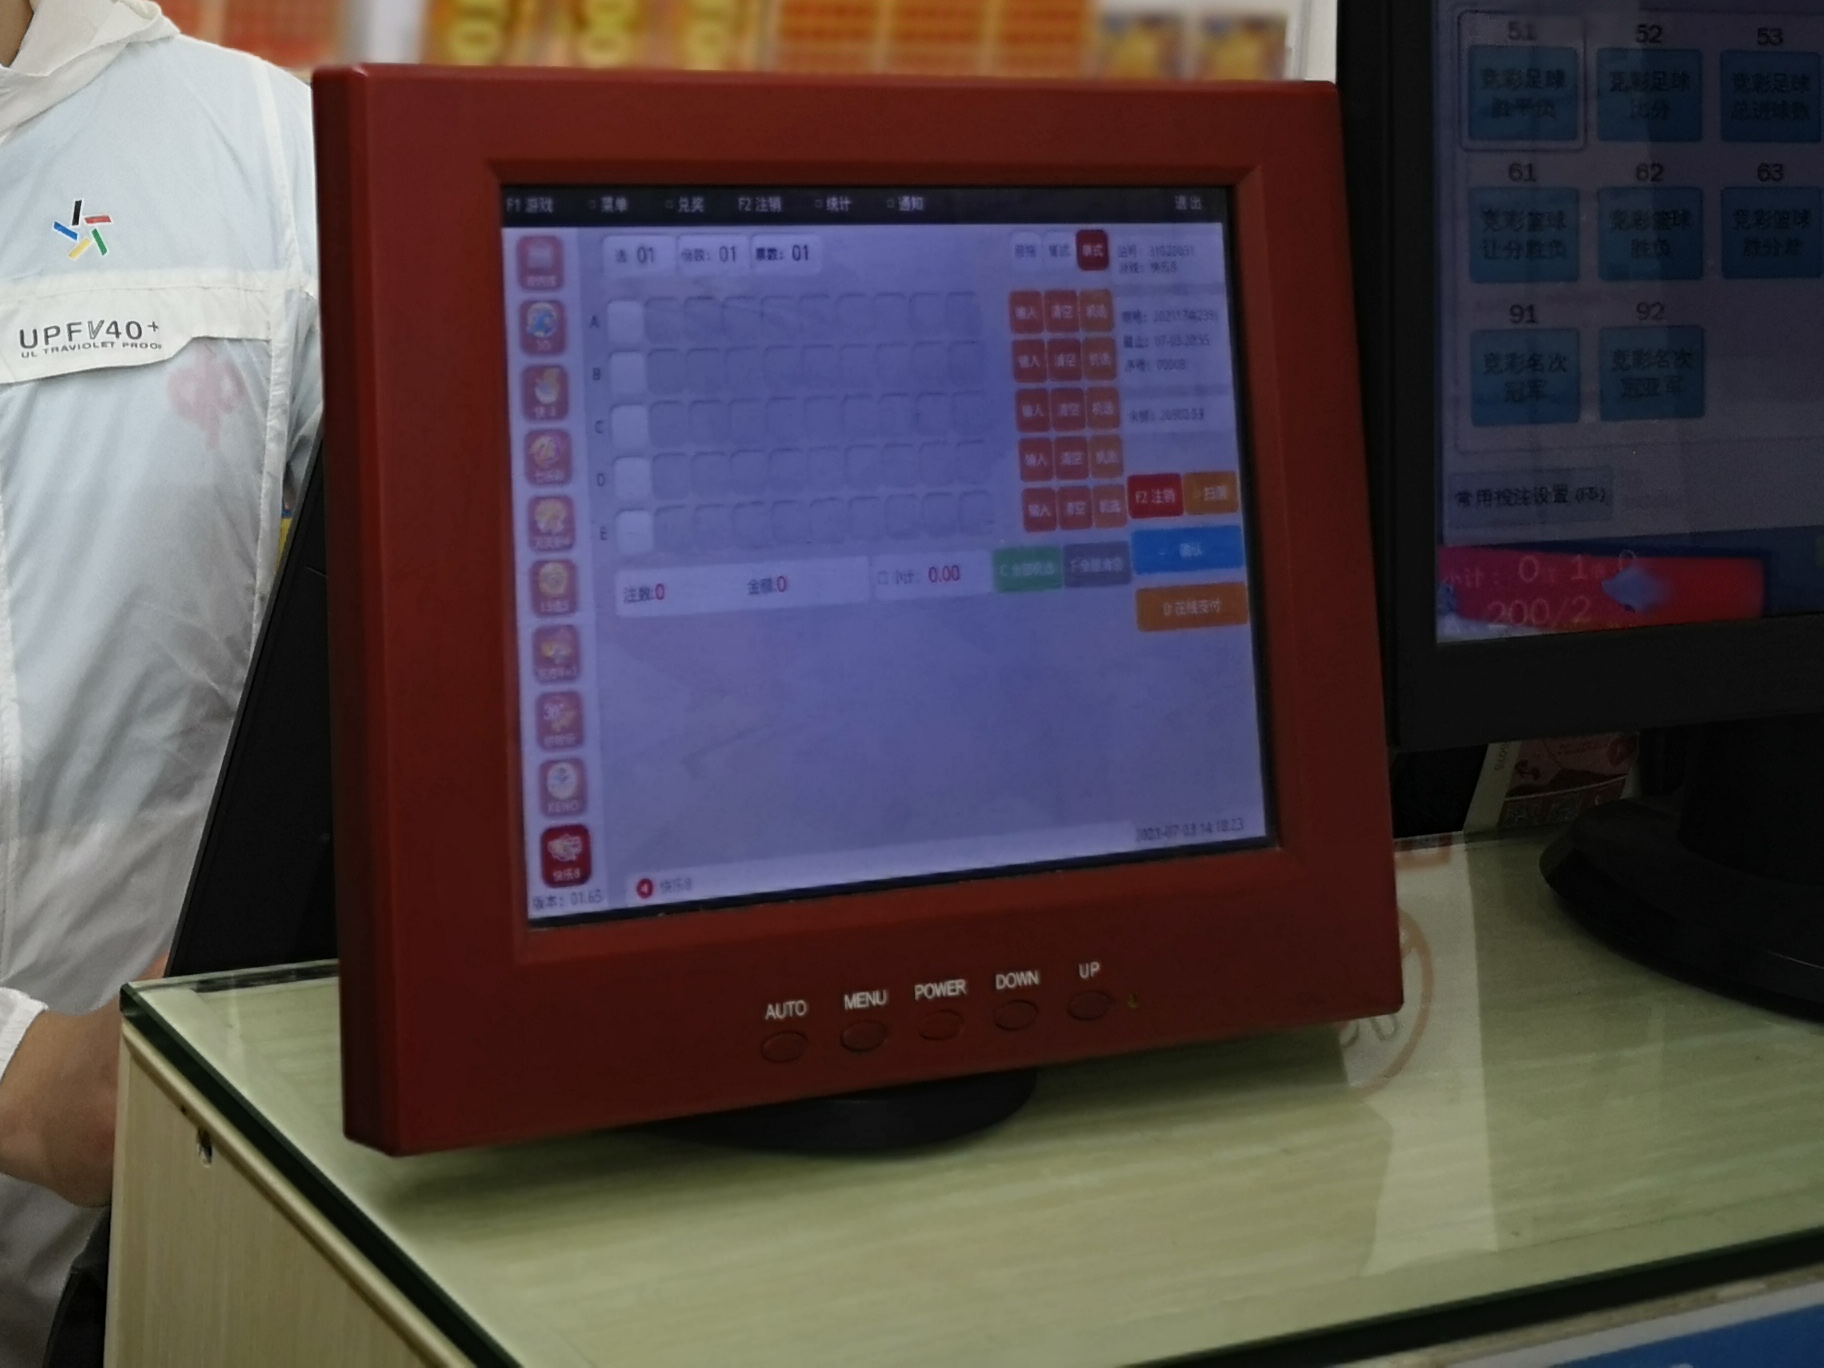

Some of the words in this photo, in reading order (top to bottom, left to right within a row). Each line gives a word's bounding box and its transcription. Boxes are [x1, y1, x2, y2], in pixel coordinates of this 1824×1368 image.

[1508, 21, 1538, 41] 51
[1636, 23, 1663, 44] 52
[1757, 27, 1784, 46] 53
[1508, 162, 1537, 183] 61
[1636, 163, 1664, 183] 62
[1757, 162, 1784, 183] 63
[738, 197, 752, 211] F2
[636, 246, 656, 264] 01
[719, 245, 737, 263] 01
[792, 244, 810, 262] 01
[1509, 304, 1538, 324] 91
[1636, 301, 1665, 322] 92
[928, 564, 960, 584] 0.00
[995, 970, 1040, 990] DOWN
[1079, 962, 1101, 980] UP
[914, 979, 967, 1001] POWER
[765, 1000, 808, 1021] AUTO
[844, 990, 888, 1011] MENU
